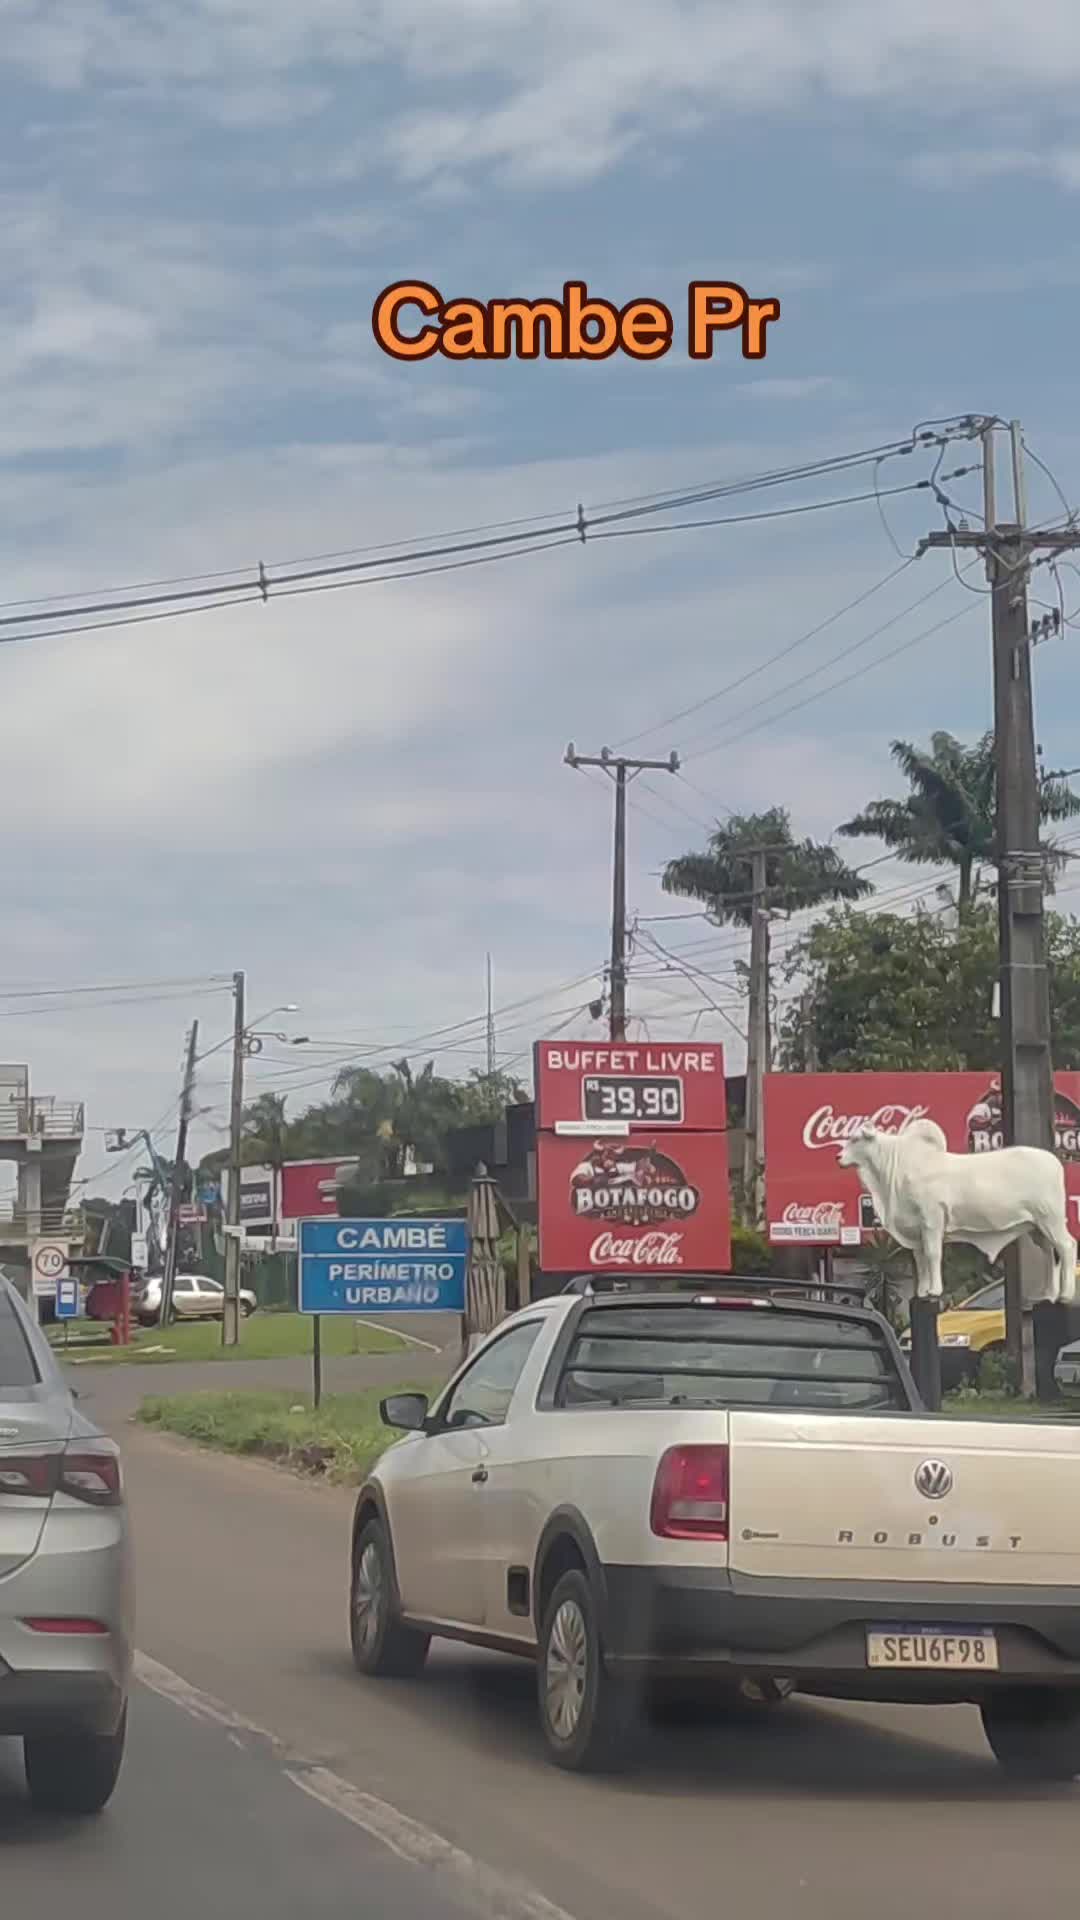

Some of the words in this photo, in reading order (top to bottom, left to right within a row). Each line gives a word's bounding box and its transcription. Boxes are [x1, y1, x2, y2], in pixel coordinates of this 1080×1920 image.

[548, 1050, 639, 1070] BUFFET
[647, 1051, 715, 1072] LIVRE
[576, 1187, 697, 1214] BOTAFOGO
[336, 1223, 447, 1249] CAMBÉ
[590, 1231, 684, 1265] Coca-Cola
[41, 1254, 60, 1268] 70
[329, 1260, 454, 1282] PERÍMETRO
[838, 1530, 1022, 1549] ROBUST
[883, 1637, 985, 1663] SEU6F98
